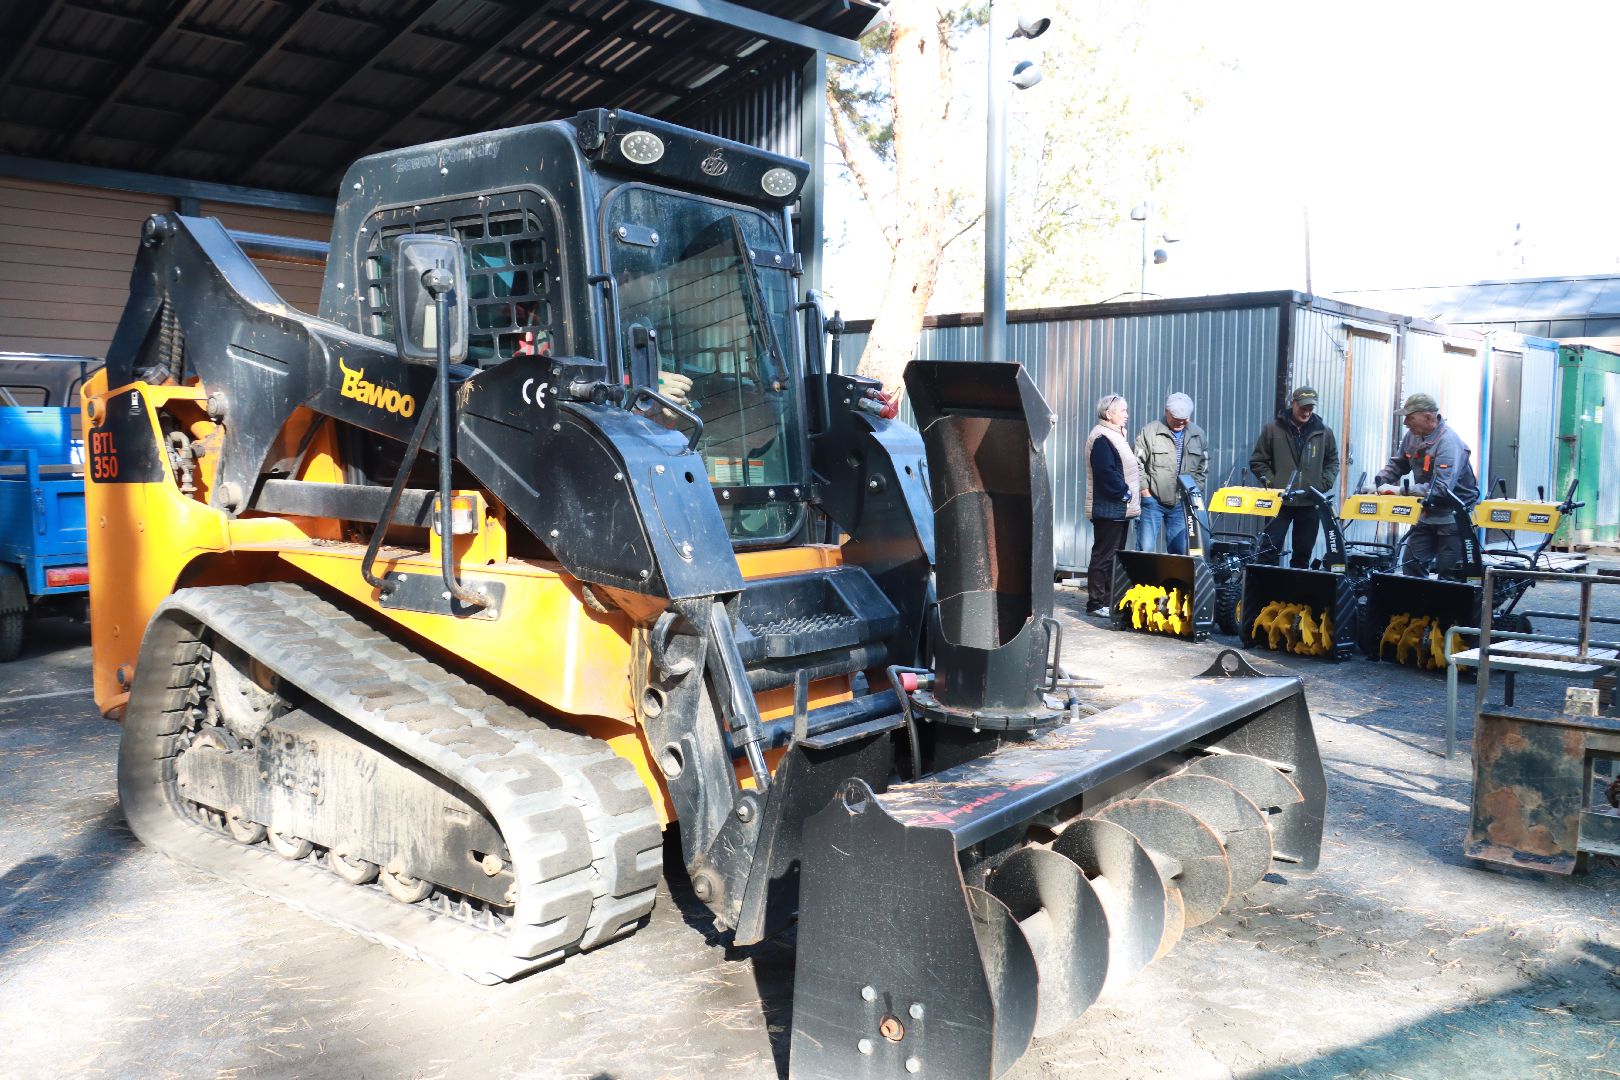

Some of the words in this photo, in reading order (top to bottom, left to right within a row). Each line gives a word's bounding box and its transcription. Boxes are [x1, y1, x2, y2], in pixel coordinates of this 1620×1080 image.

[340, 357, 415, 417] Bawoo
[92, 432, 117, 454] BTL
[94, 456, 118, 478] 350
